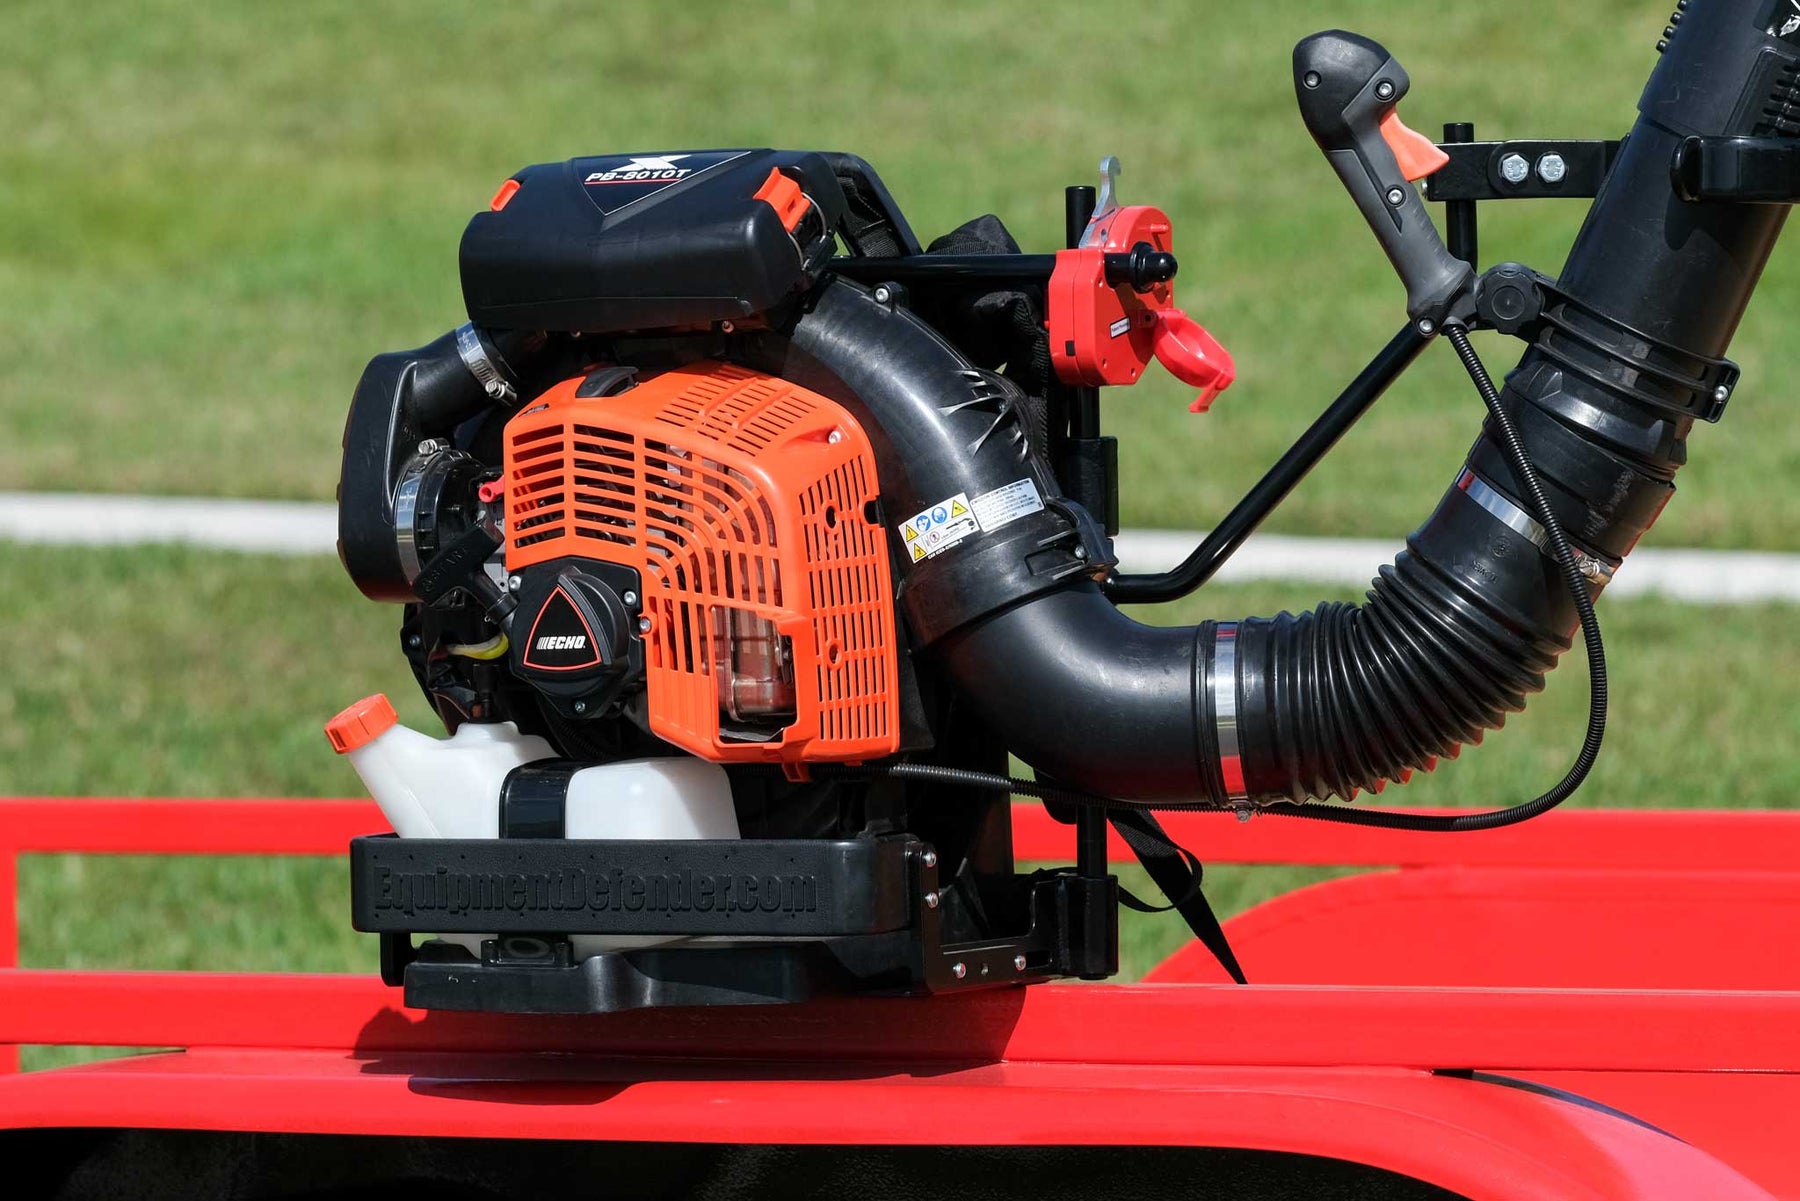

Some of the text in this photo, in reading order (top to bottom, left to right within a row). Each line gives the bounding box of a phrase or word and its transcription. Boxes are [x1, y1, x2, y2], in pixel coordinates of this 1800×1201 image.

[585, 169, 692, 182] PB-8010T
[545, 635, 586, 650] ECHO
[373, 866, 817, 914] EquipmentDefender.com
